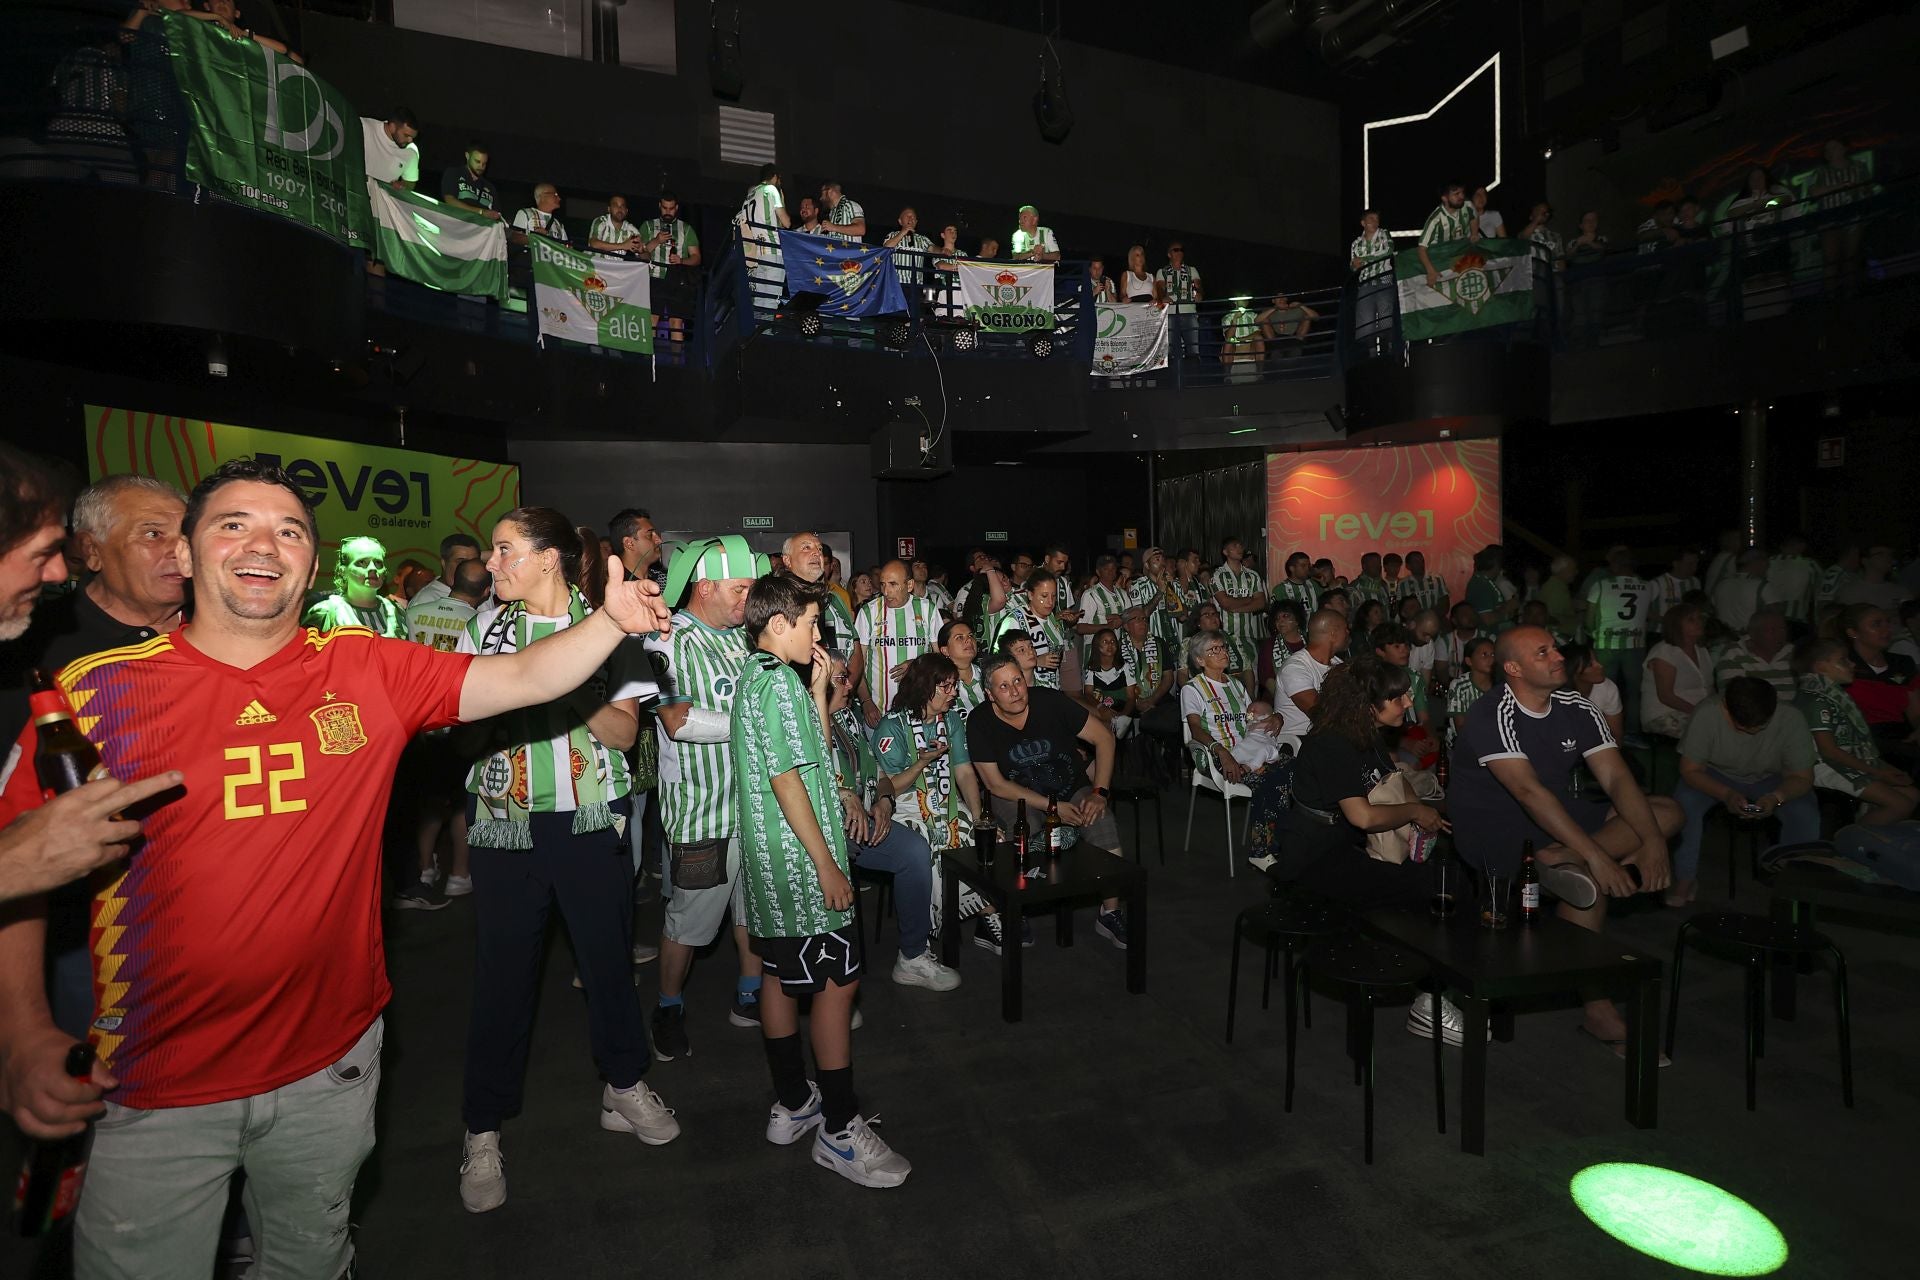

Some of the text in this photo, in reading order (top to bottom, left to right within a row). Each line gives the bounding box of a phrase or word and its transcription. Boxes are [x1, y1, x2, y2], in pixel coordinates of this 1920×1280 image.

[240, 184, 261, 201] 100
[266, 172, 306, 198] 1907
[319, 193, 348, 217] 200
[608, 314, 647, 342] alé!
[368, 514, 432, 528] @salarever
[746, 518, 771, 526] SALIDA
[1617, 593, 1638, 620] 3
[874, 635, 926, 647] PEÑA BÉTICA
[235, 714, 278, 726] adidas
[223, 741, 308, 820] 22
